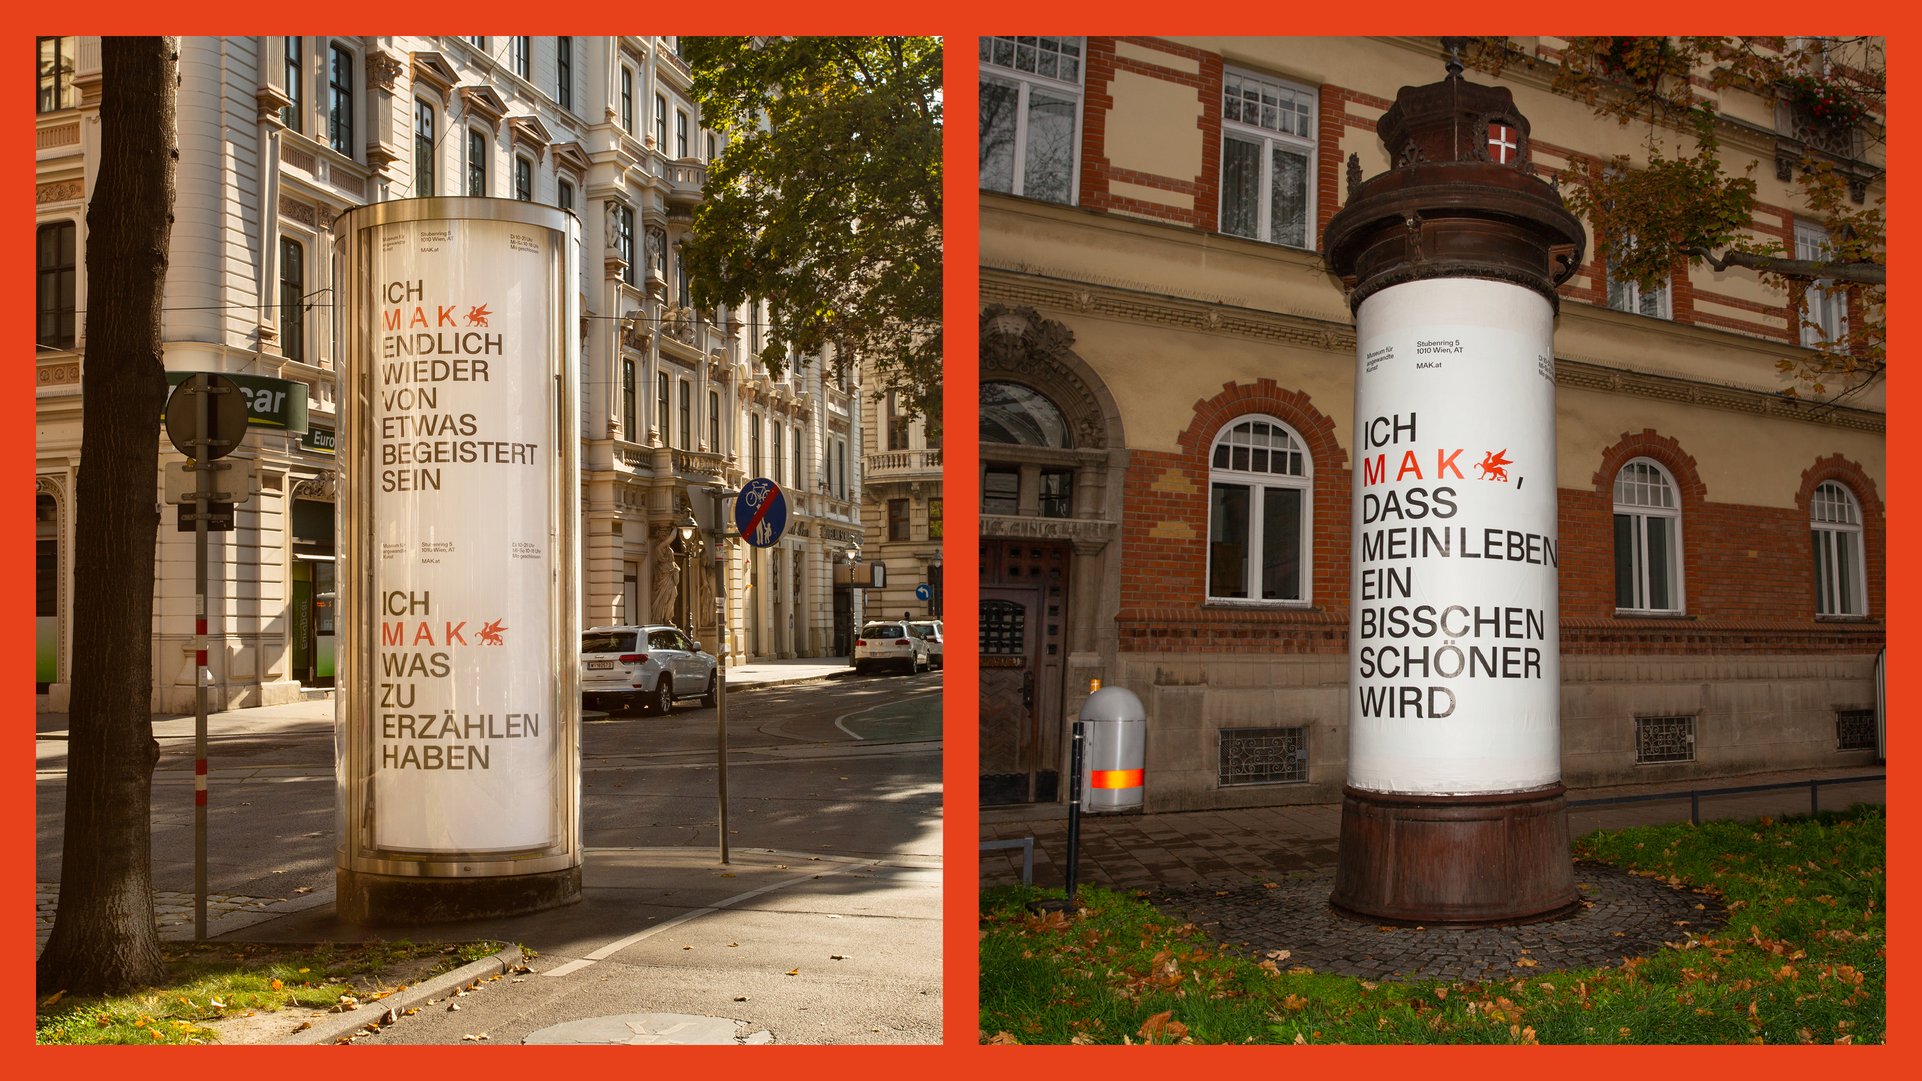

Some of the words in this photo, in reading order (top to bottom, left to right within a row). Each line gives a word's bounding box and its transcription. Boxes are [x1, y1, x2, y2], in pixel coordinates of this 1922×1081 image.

[383, 280, 423, 305] ICH
[383, 332, 503, 359] ENDLICH
[1366, 349, 1385, 359] Museum
[1385, 345, 1394, 353] für
[1416, 340, 1454, 348] Stubenring
[382, 359, 489, 385] WIEDER
[382, 387, 437, 412] VON
[382, 414, 478, 439] ETWAS
[1364, 412, 1416, 450] ICH
[382, 441, 538, 465] BEGEISTERT
[382, 468, 441, 493] SEIN
[1363, 487, 1458, 525] DASS
[1362, 526, 1451, 563] MEIN
[1460, 527, 1558, 569] LEBEN
[1362, 566, 1412, 600] EIN
[382, 591, 430, 616] ICH
[1361, 604, 1545, 640] BISSCHEN
[382, 652, 451, 678] WAS
[1359, 639, 1542, 679] SCHÖNER
[380, 683, 416, 708] ZU
[1359, 685, 1457, 719] WIRD
[382, 710, 539, 739] ERZÄHLEN
[382, 744, 490, 770] HABEN
